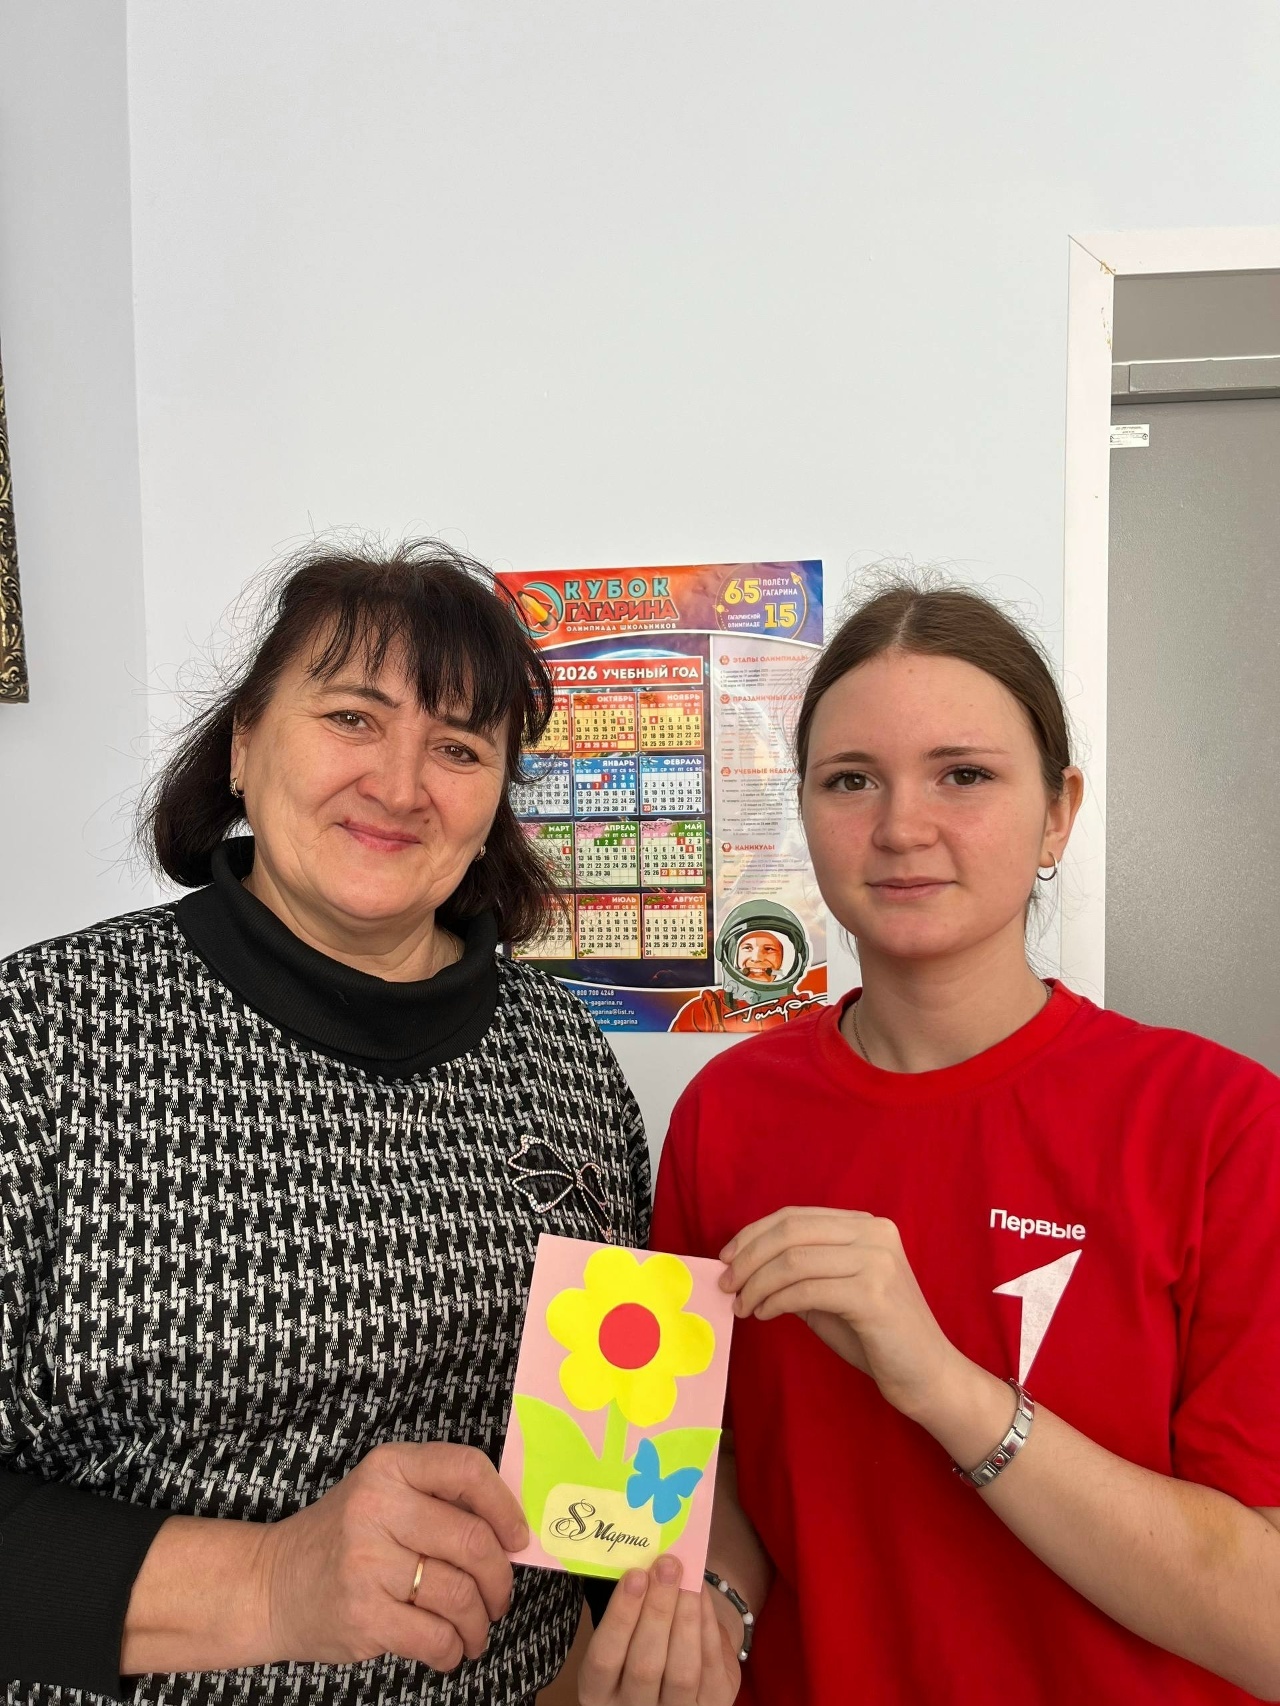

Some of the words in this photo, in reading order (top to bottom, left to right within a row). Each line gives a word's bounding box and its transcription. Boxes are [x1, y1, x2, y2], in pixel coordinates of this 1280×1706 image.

[564, 578, 669, 600] КУБОК
[724, 578, 762, 604] 65
[762, 577, 789, 586] ПОЛЁТУ
[565, 599, 679, 622] ГАГАРИНА
[764, 602, 797, 628] 15
[548, 666, 597, 681] /2026
[602, 665, 668, 679] УЧЕБНЫЙ
[672, 666, 698, 678] ГОД
[685, 822, 702, 830] МАЙ
[990, 1208, 1086, 1240] Первые
[549, 1499, 596, 1541] 8
[594, 1520, 650, 1552] Марта
